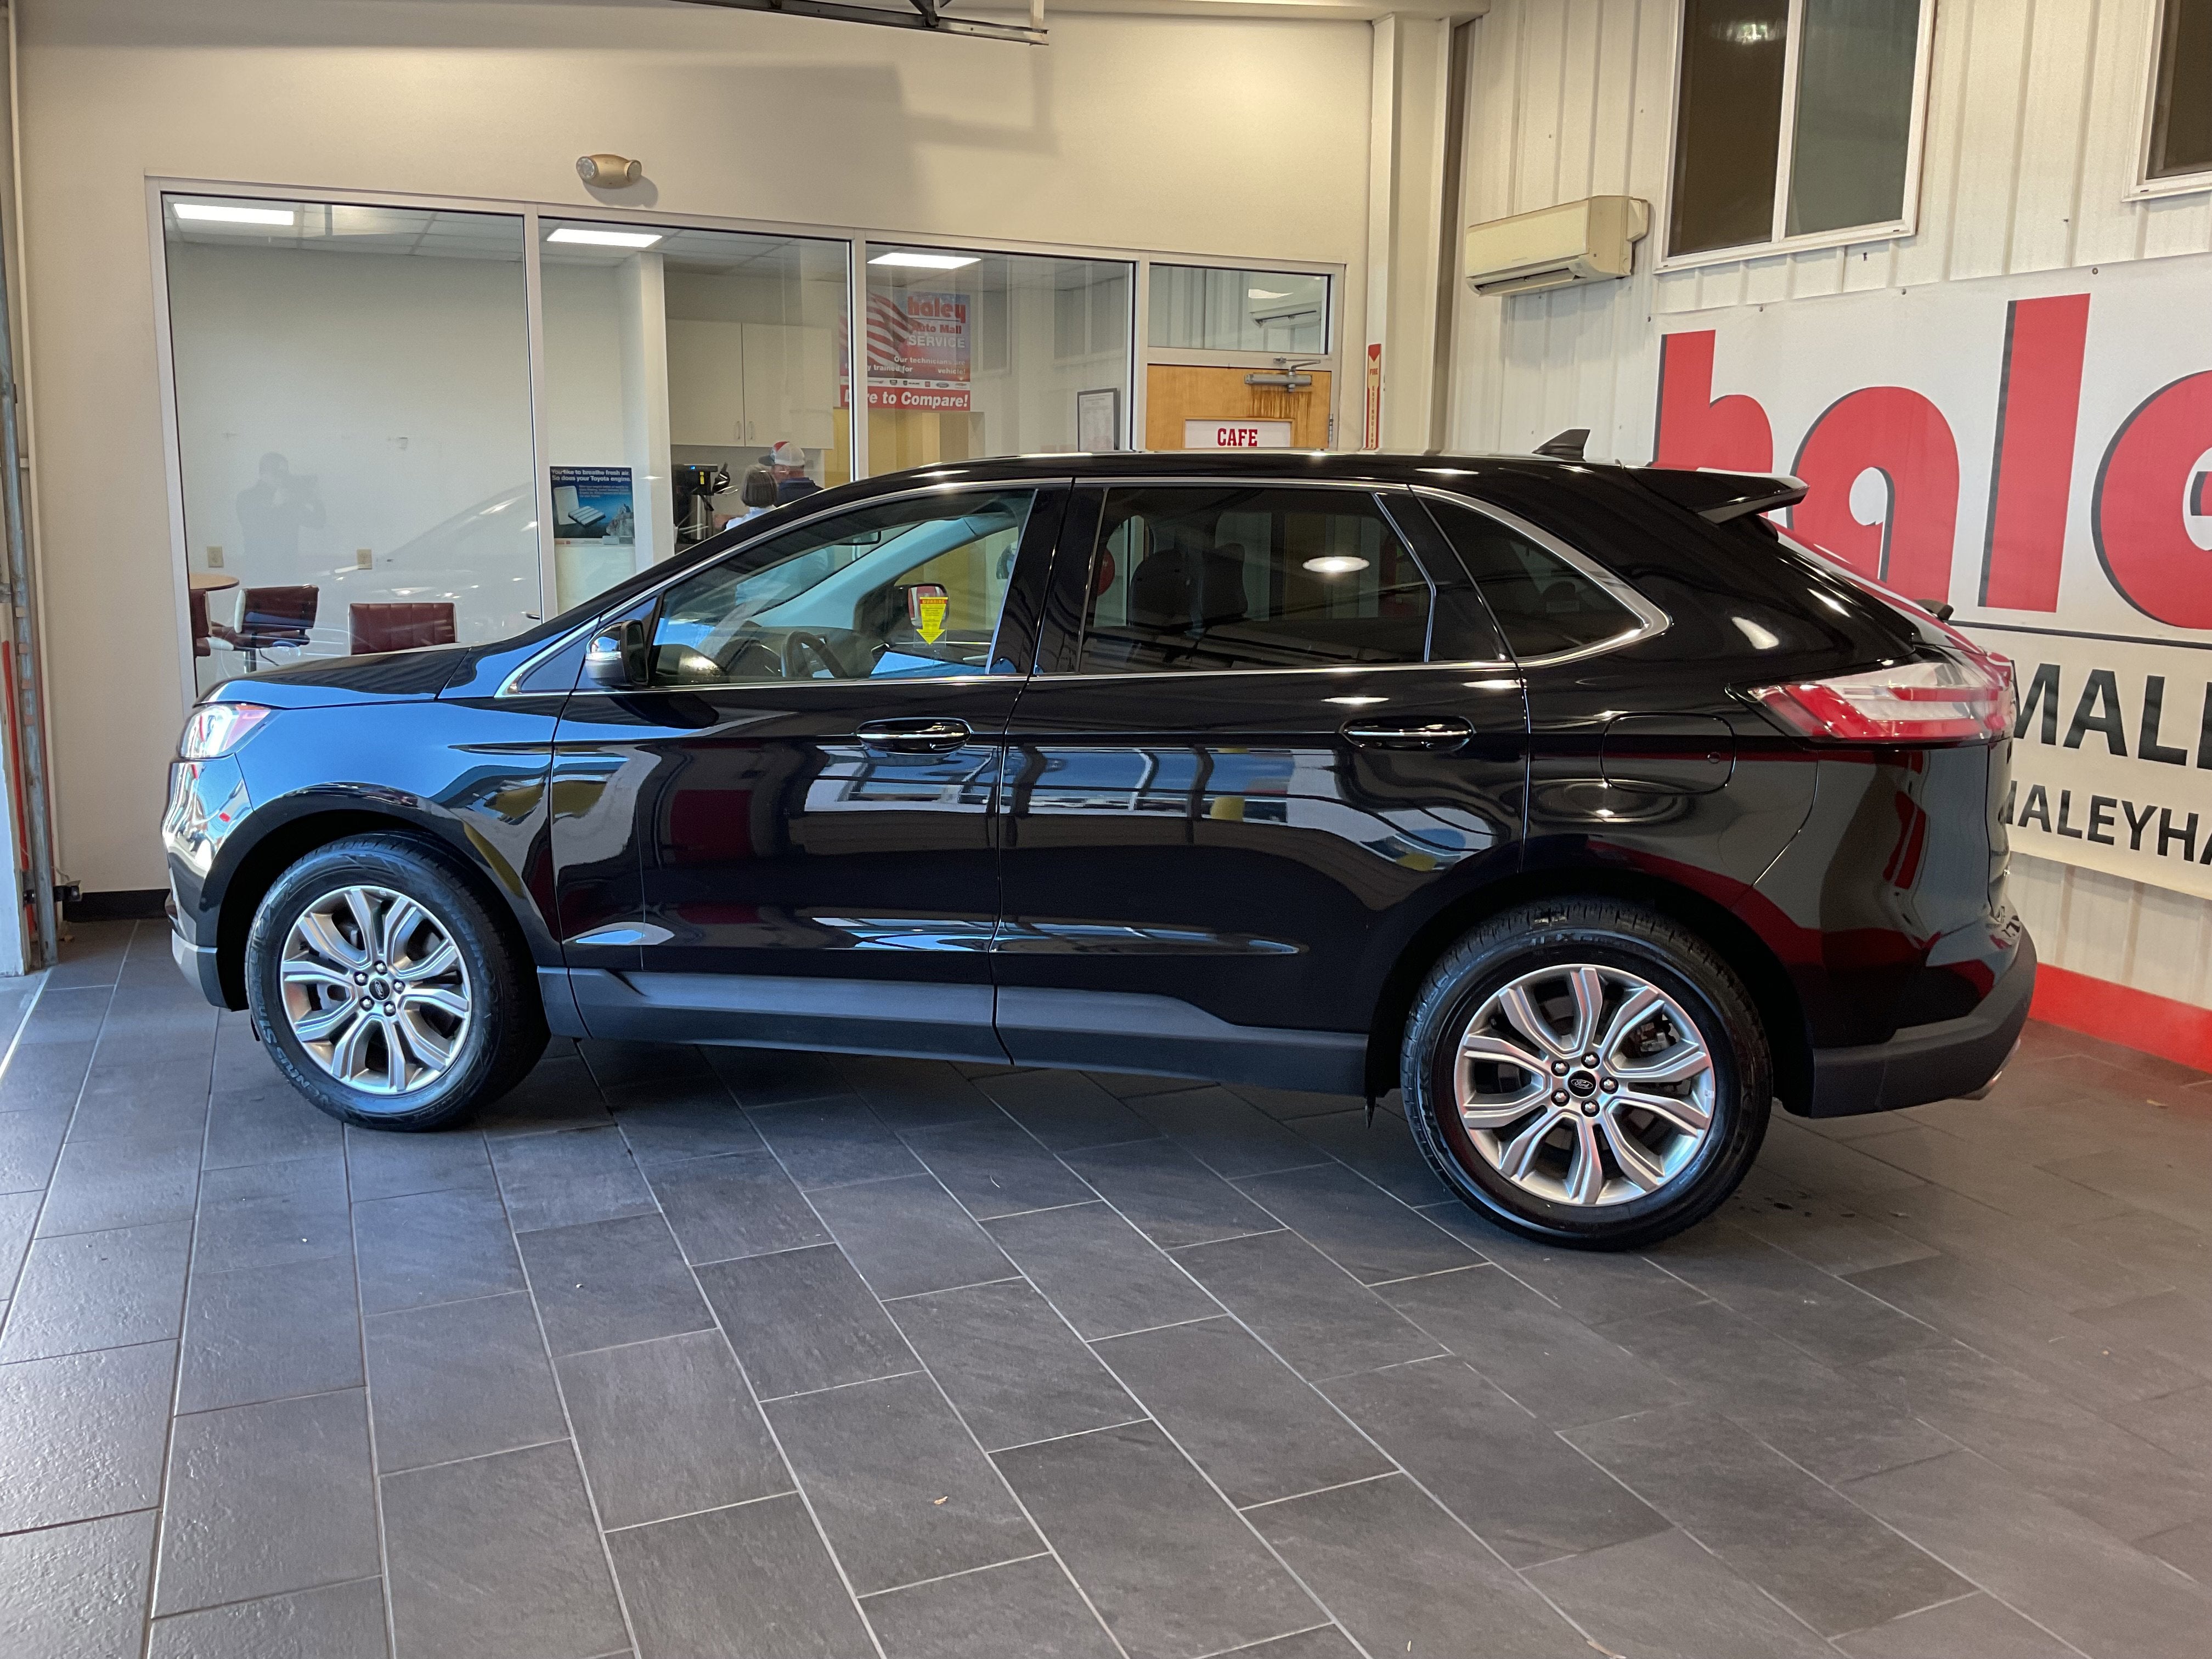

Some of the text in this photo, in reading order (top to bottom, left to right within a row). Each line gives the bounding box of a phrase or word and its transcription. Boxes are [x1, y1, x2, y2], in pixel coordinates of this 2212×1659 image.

[907, 296, 966, 323] haley
[940, 325, 962, 334] Mall
[908, 335, 965, 348] SERVICE
[882, 391, 897, 404] to
[901, 392, 968, 409] Compare!
[1217, 428, 1257, 447] CAFE
